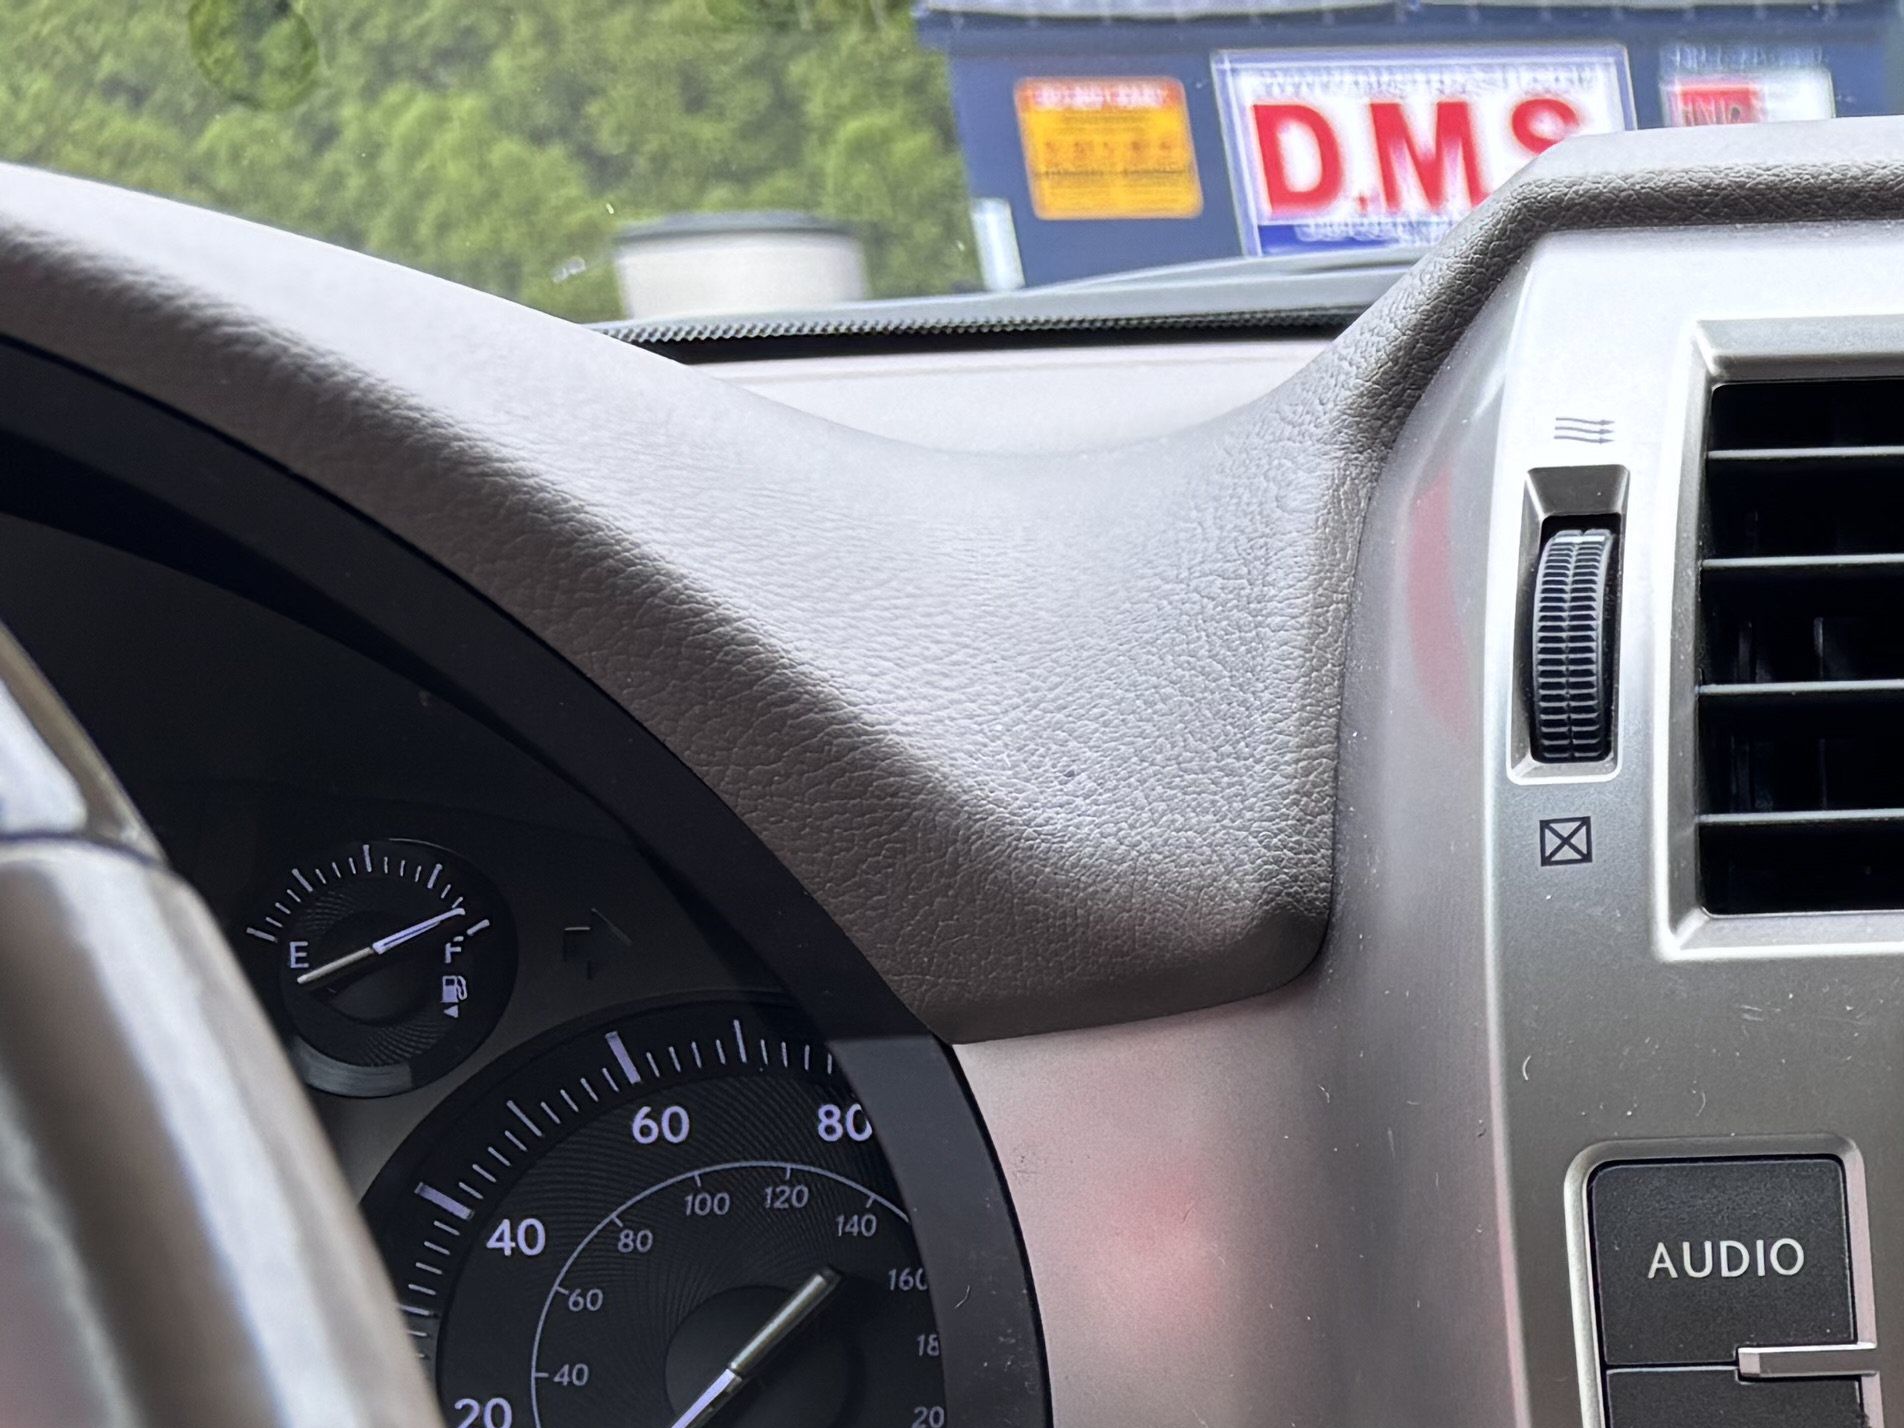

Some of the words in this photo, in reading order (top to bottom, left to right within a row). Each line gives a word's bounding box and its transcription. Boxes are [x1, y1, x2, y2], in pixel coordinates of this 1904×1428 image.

[289, 941, 309, 968] E
[444, 936, 464, 964] F
[631, 1106, 690, 1144] 60
[816, 1104, 873, 1142] 80
[683, 1190, 731, 1217] 100
[763, 1183, 810, 1210] 120
[486, 1217, 546, 1257] 40
[834, 1213, 878, 1238] 140
[617, 1228, 653, 1254] 80
[1647, 1237, 1804, 1280] AUDIO
[567, 1287, 603, 1313] 60
[916, 1333, 940, 1357] 18
[553, 1362, 589, 1388] 40
